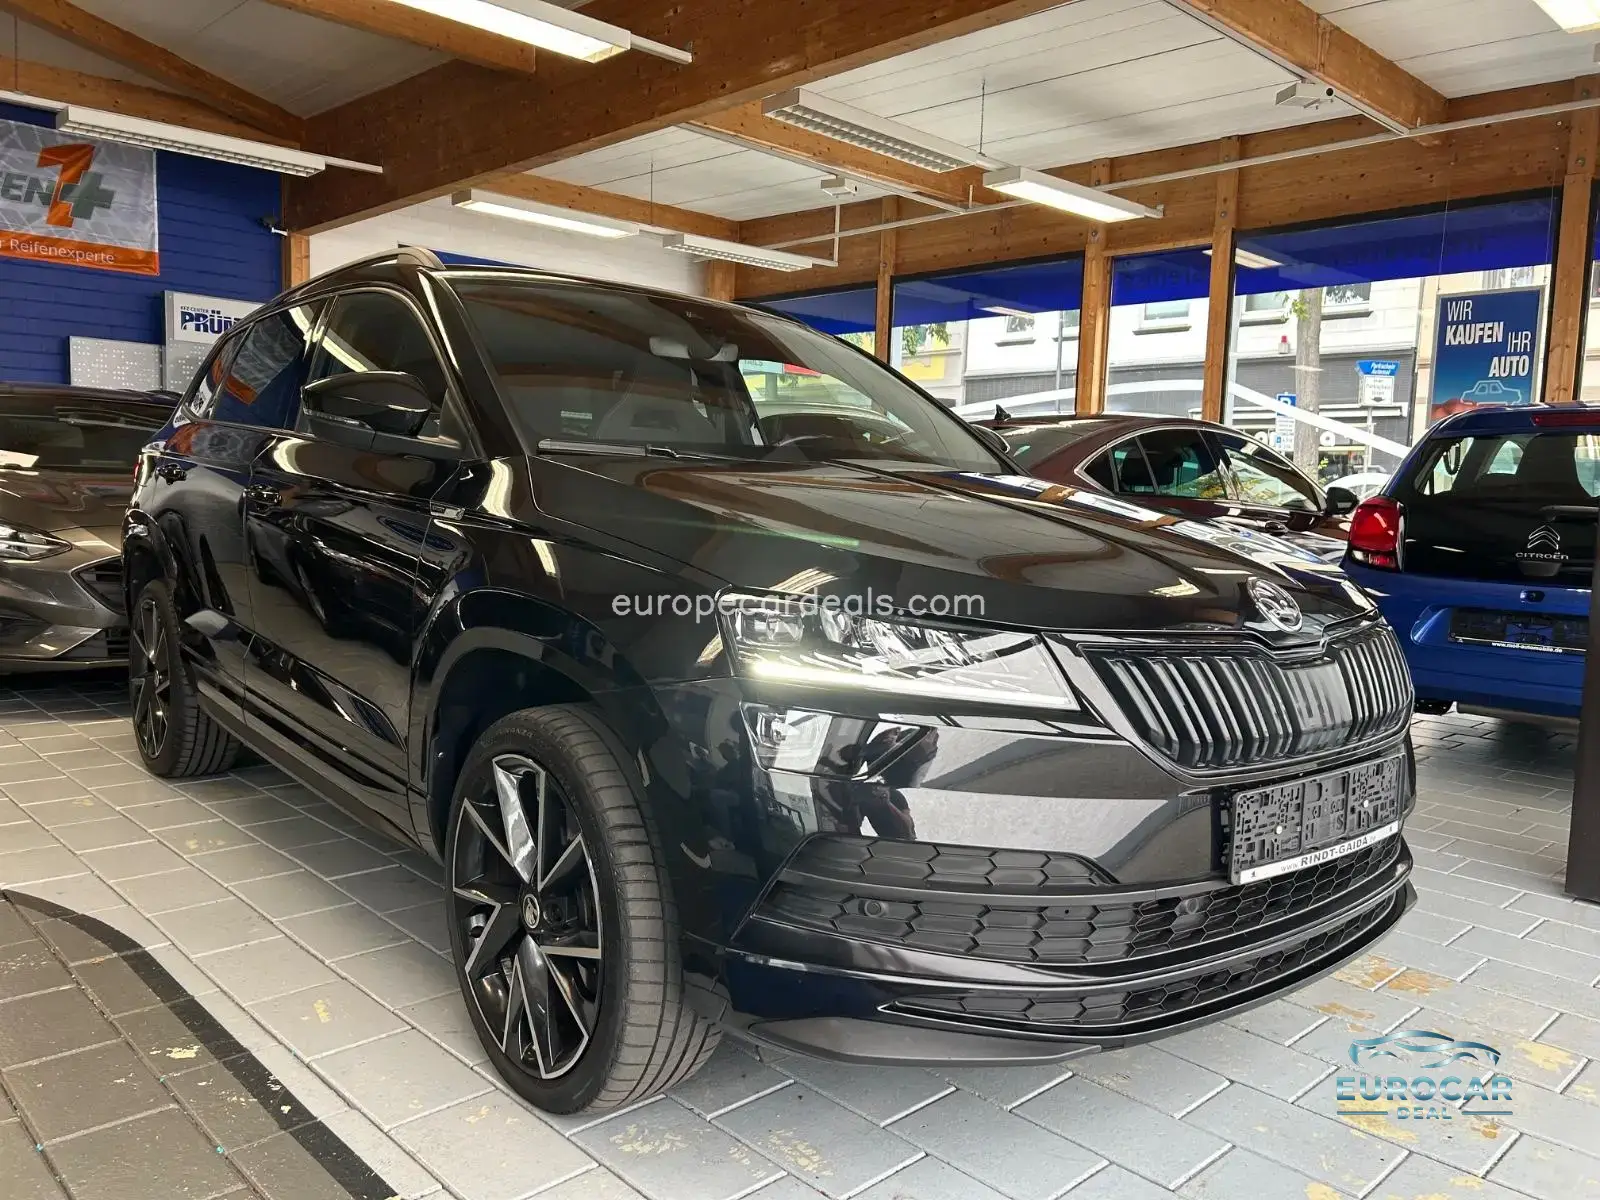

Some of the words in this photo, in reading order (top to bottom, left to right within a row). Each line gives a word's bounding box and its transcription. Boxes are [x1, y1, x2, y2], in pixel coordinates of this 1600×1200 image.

[10, 239, 115, 264] Reifenexperte
[1447, 300, 1473, 322] WIR
[1445, 321, 1504, 346] KAUFEN
[1507, 331, 1532, 353] IHR
[1488, 355, 1530, 378] AUTO
[1515, 552, 1569, 560] CITROËN
